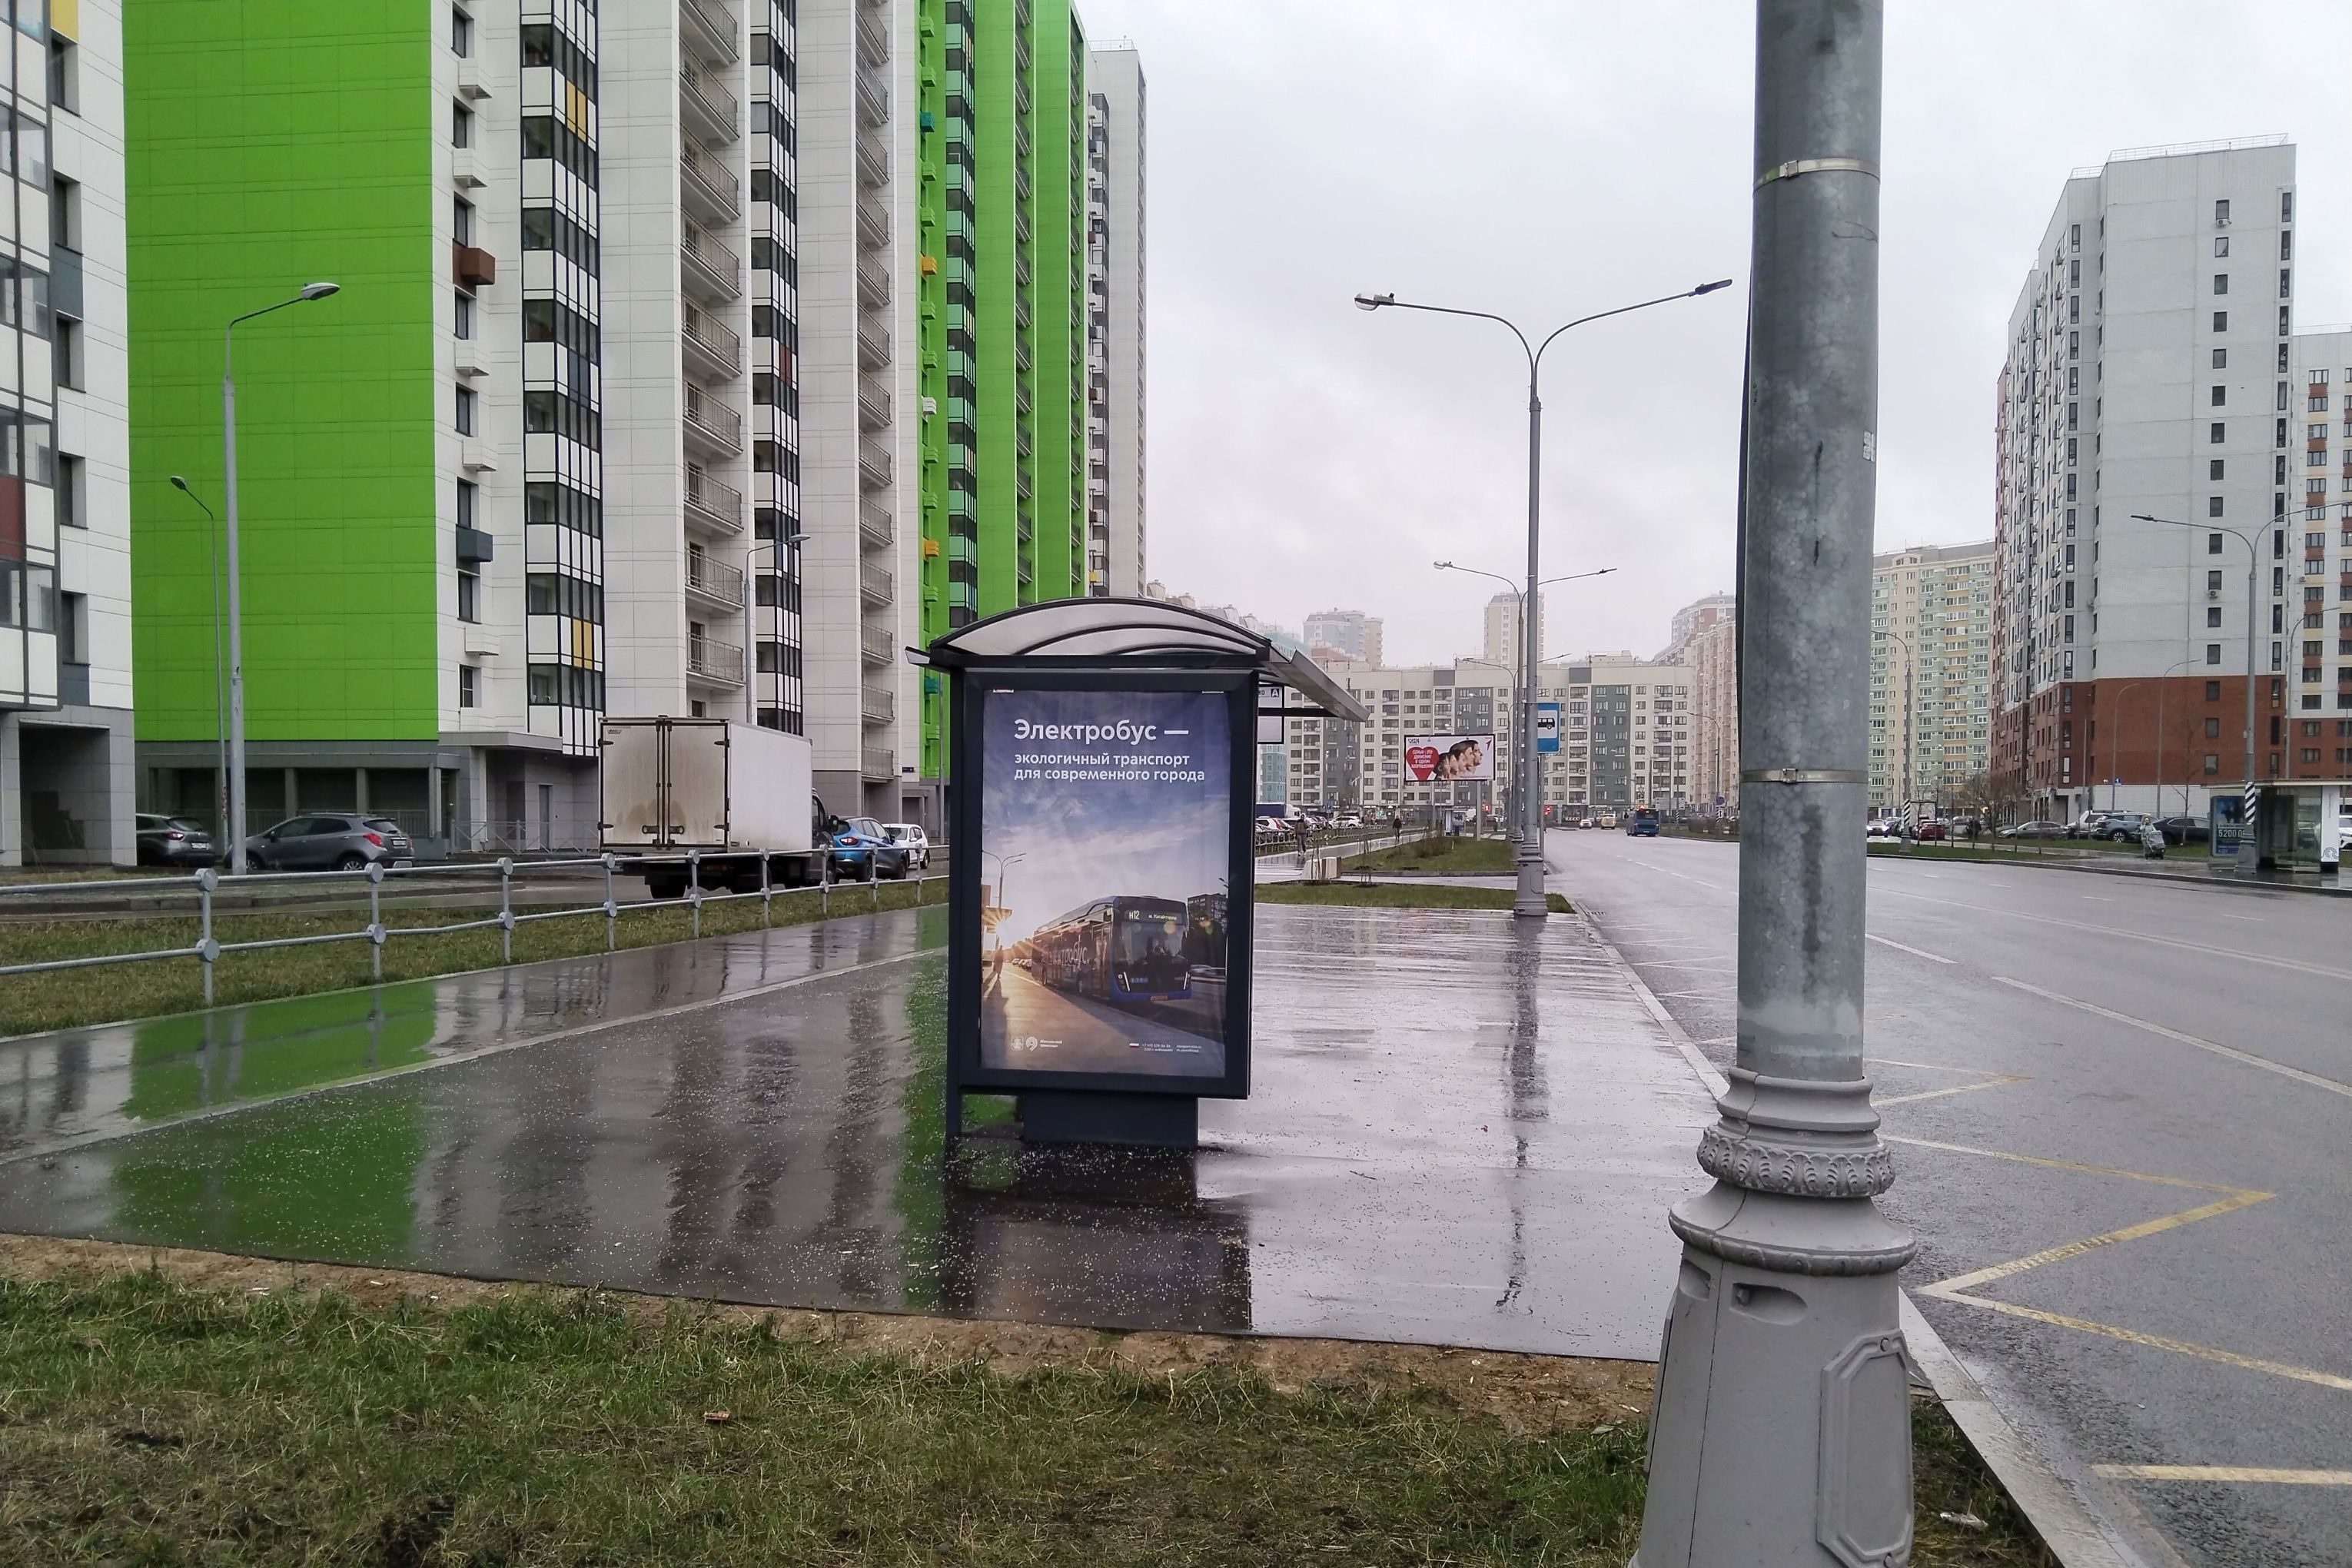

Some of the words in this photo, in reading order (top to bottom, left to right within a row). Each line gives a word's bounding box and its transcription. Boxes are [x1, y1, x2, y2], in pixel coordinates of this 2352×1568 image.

[1015, 719, 1156, 745] Электробус
[1015, 752, 1109, 764] экологичный
[1113, 756, 1189, 767] транспорт
[1015, 769, 1040, 781] для
[1045, 770, 1149, 782] современного
[1154, 771, 1204, 782] города
